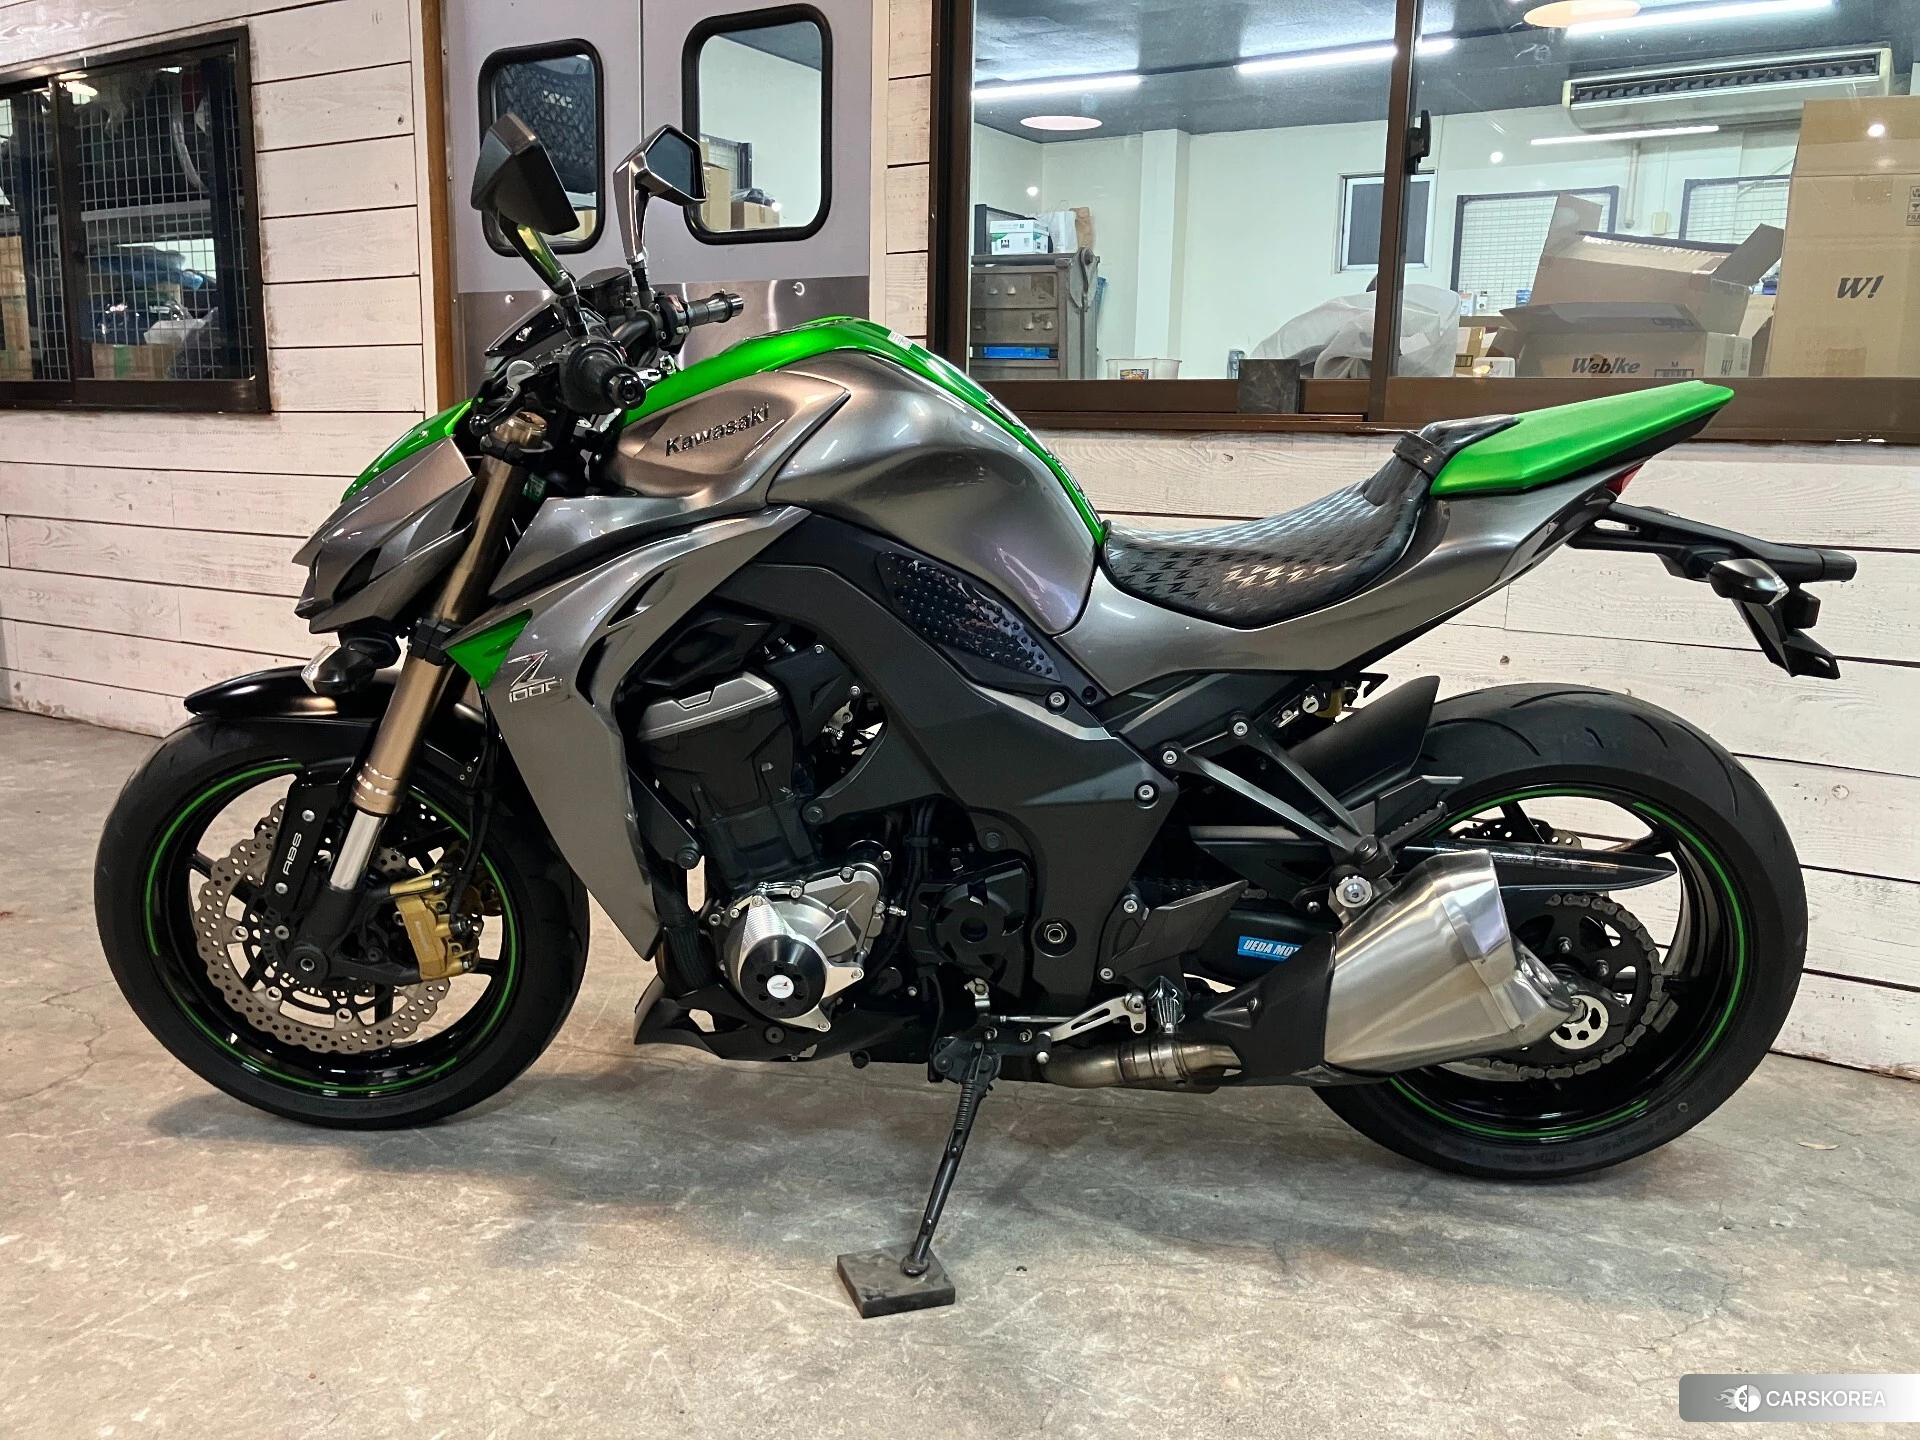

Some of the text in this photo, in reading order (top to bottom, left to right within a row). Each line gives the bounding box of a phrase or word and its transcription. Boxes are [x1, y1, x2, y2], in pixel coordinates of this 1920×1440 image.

[1837, 275, 1884, 299] W!
[666, 401, 770, 457] Kawasaki
[507, 649, 556, 692] Z
[282, 832, 302, 876] ABS
[1243, 939, 1274, 954] UEDA
